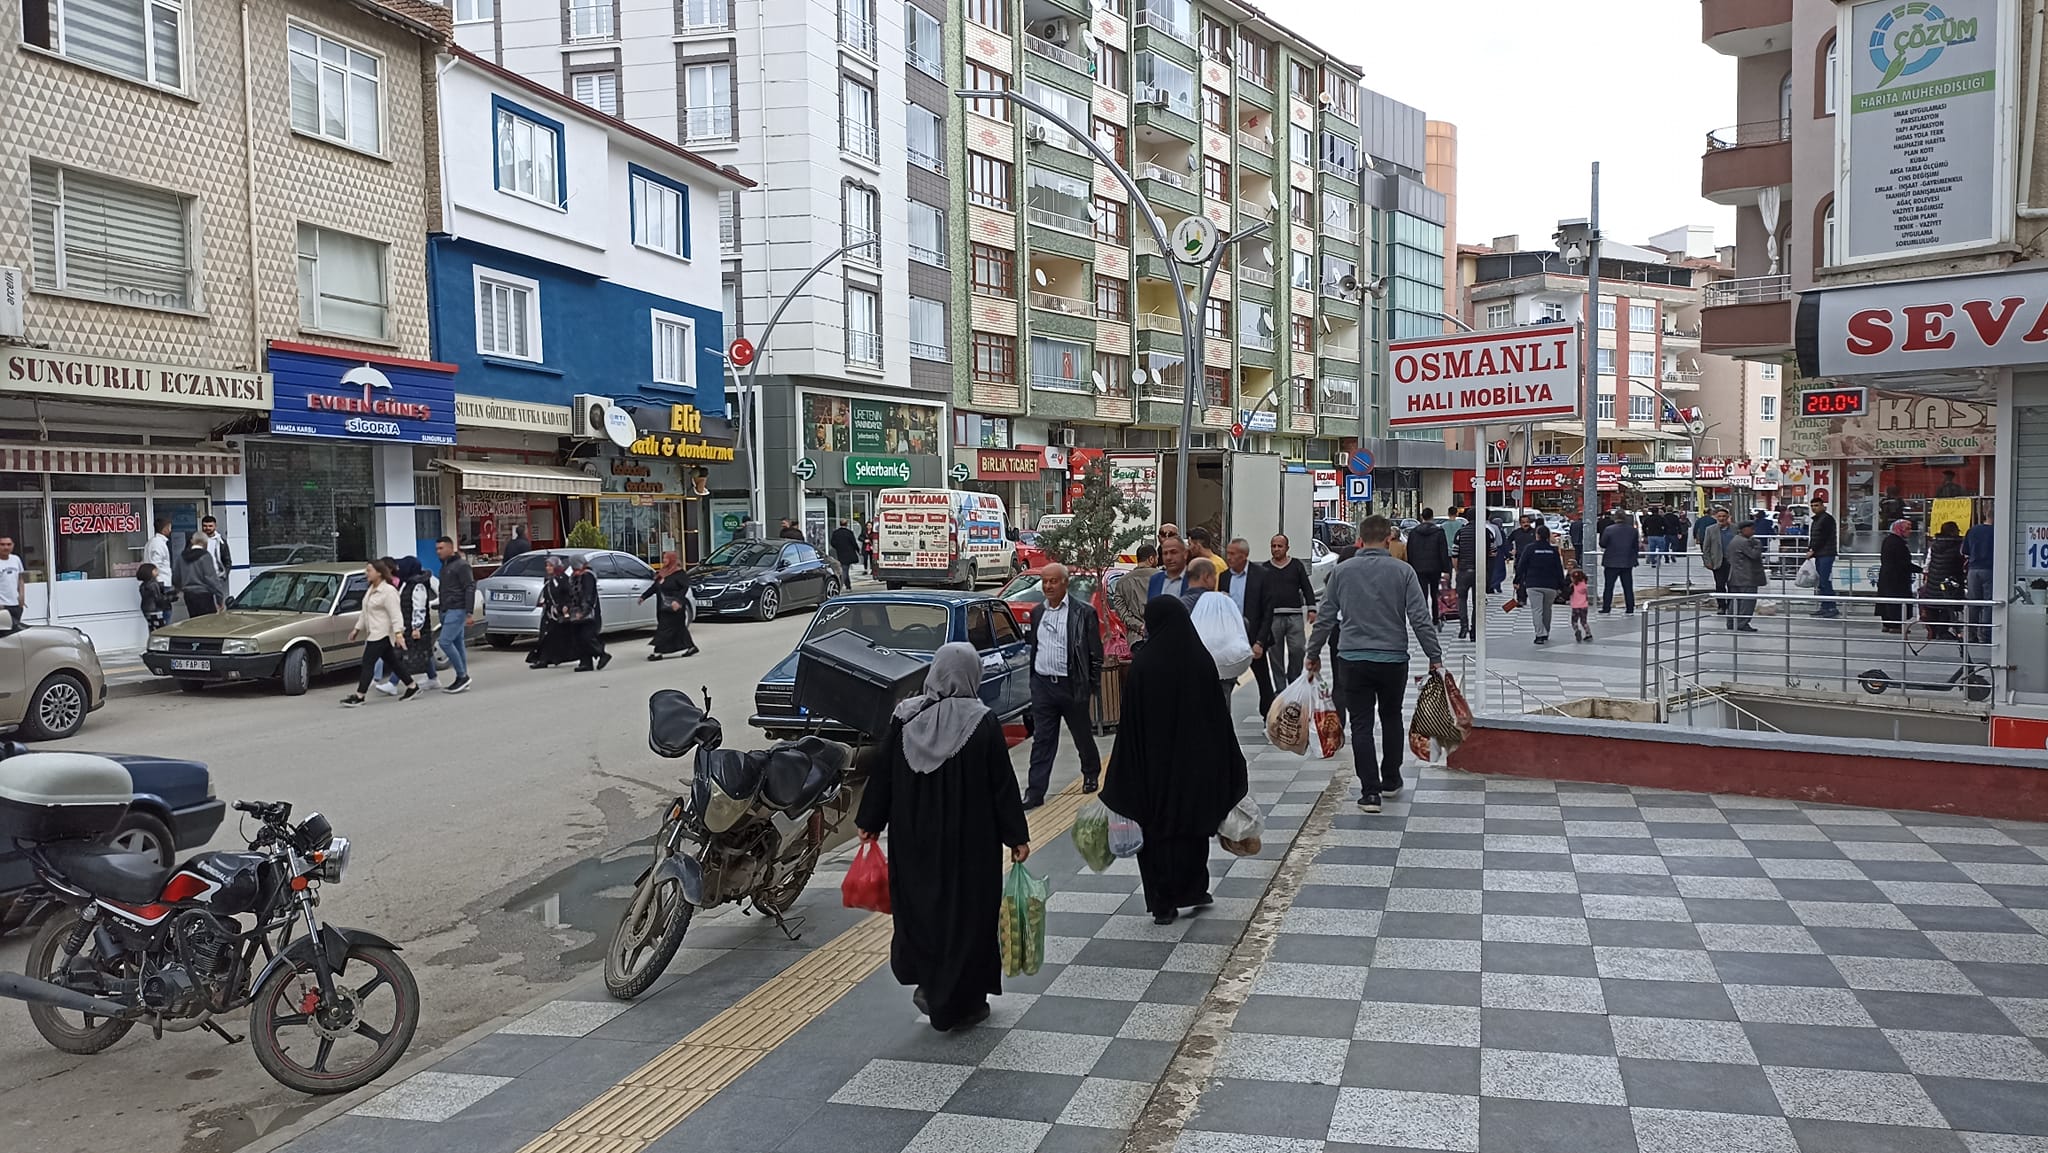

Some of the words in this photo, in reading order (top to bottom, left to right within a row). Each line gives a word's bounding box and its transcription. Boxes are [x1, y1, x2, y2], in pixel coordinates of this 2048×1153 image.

[1894, 16, 1978, 54] ÇÖZÜM
[1395, 340, 1568, 384] OSMANLI
[8, 356, 152, 393] SUNGURLU
[161, 371, 266, 402] ECZANESİ
[307, 393, 371, 414] EVREN
[373, 398, 432, 421] GÜNEŞ
[1407, 391, 1453, 412] HALI
[1460, 382, 1553, 408] MOBİLYA
[1807, 394, 1858, 412] 20.04
[456, 401, 484, 419] SULTAN
[670, 403, 702, 434] Elit
[1877, 398, 1996, 431] KAS
[347, 417, 400, 436] SİGORTA
[677, 438, 734, 461] dondurma
[1875, 438, 1927, 449] Pastırma
[1940, 436, 1979, 448] Sucuk
[855, 461, 899, 480] Şekerbank
[1354, 480, 1365, 495] D
[68, 502, 131, 518] SUNGURLU
[883, 494, 906, 504] HALI
[908, 495, 948, 505] YIKAMA
[59, 512, 141, 535] ECZANESİ
